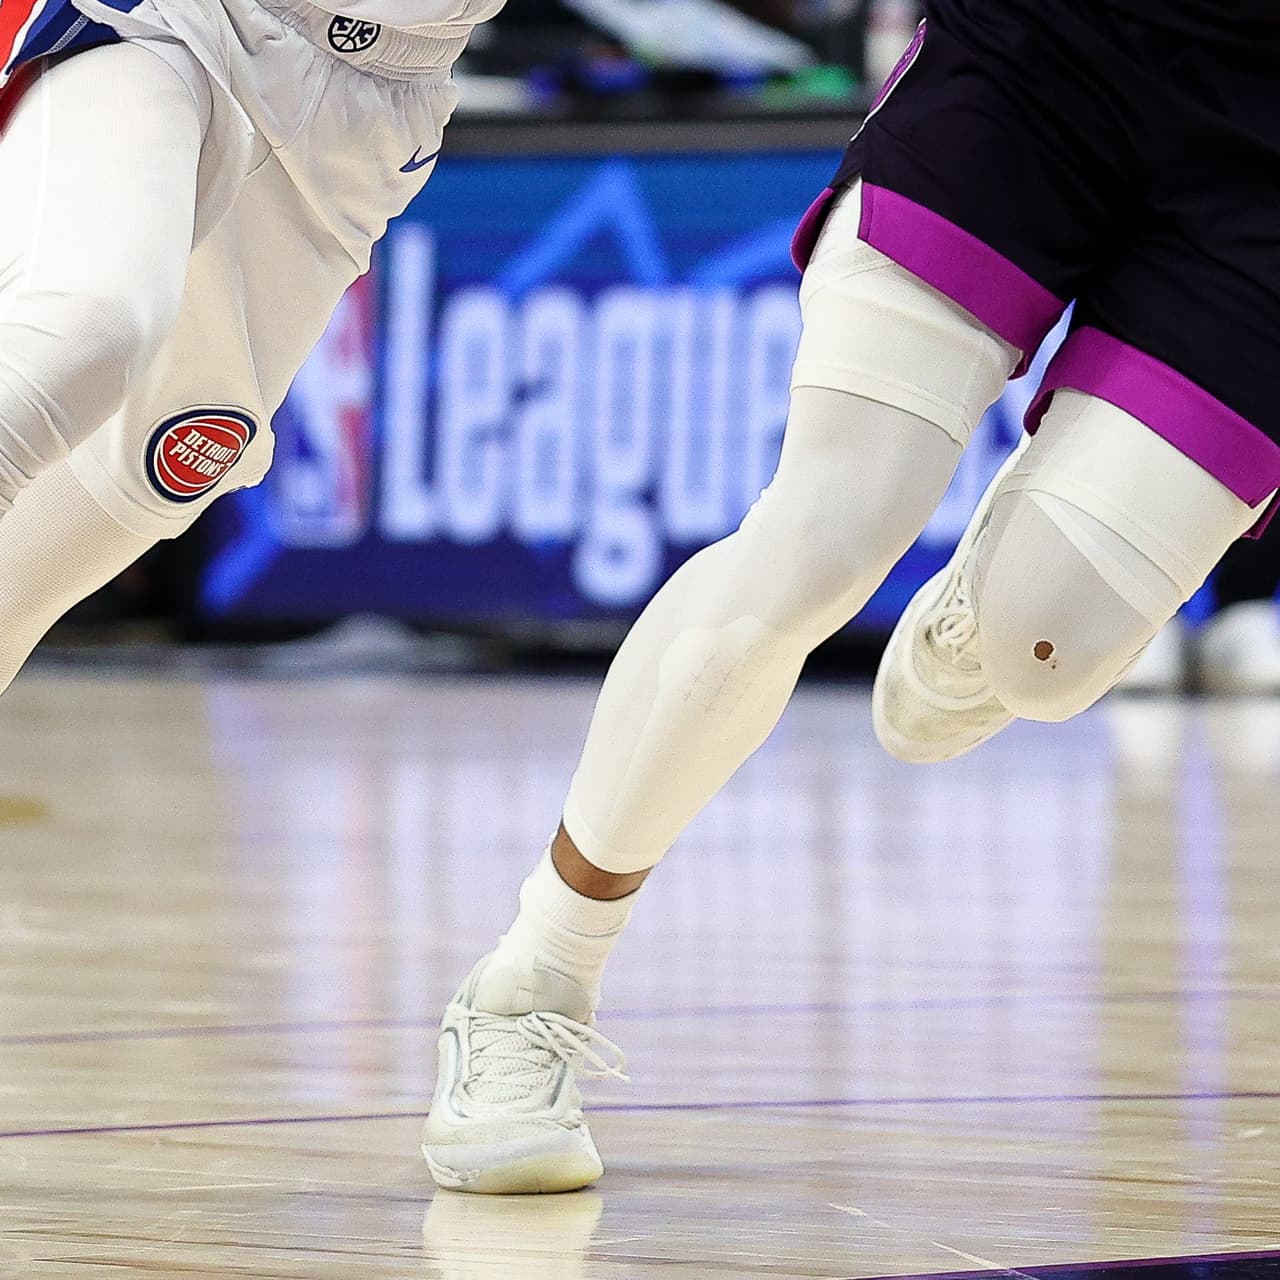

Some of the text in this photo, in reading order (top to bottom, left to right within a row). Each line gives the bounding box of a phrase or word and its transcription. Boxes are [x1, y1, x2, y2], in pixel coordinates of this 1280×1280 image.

[380, 223, 803, 607] League
[168, 441, 225, 478] PISTONS
[182, 428, 238, 463] DETROIT
